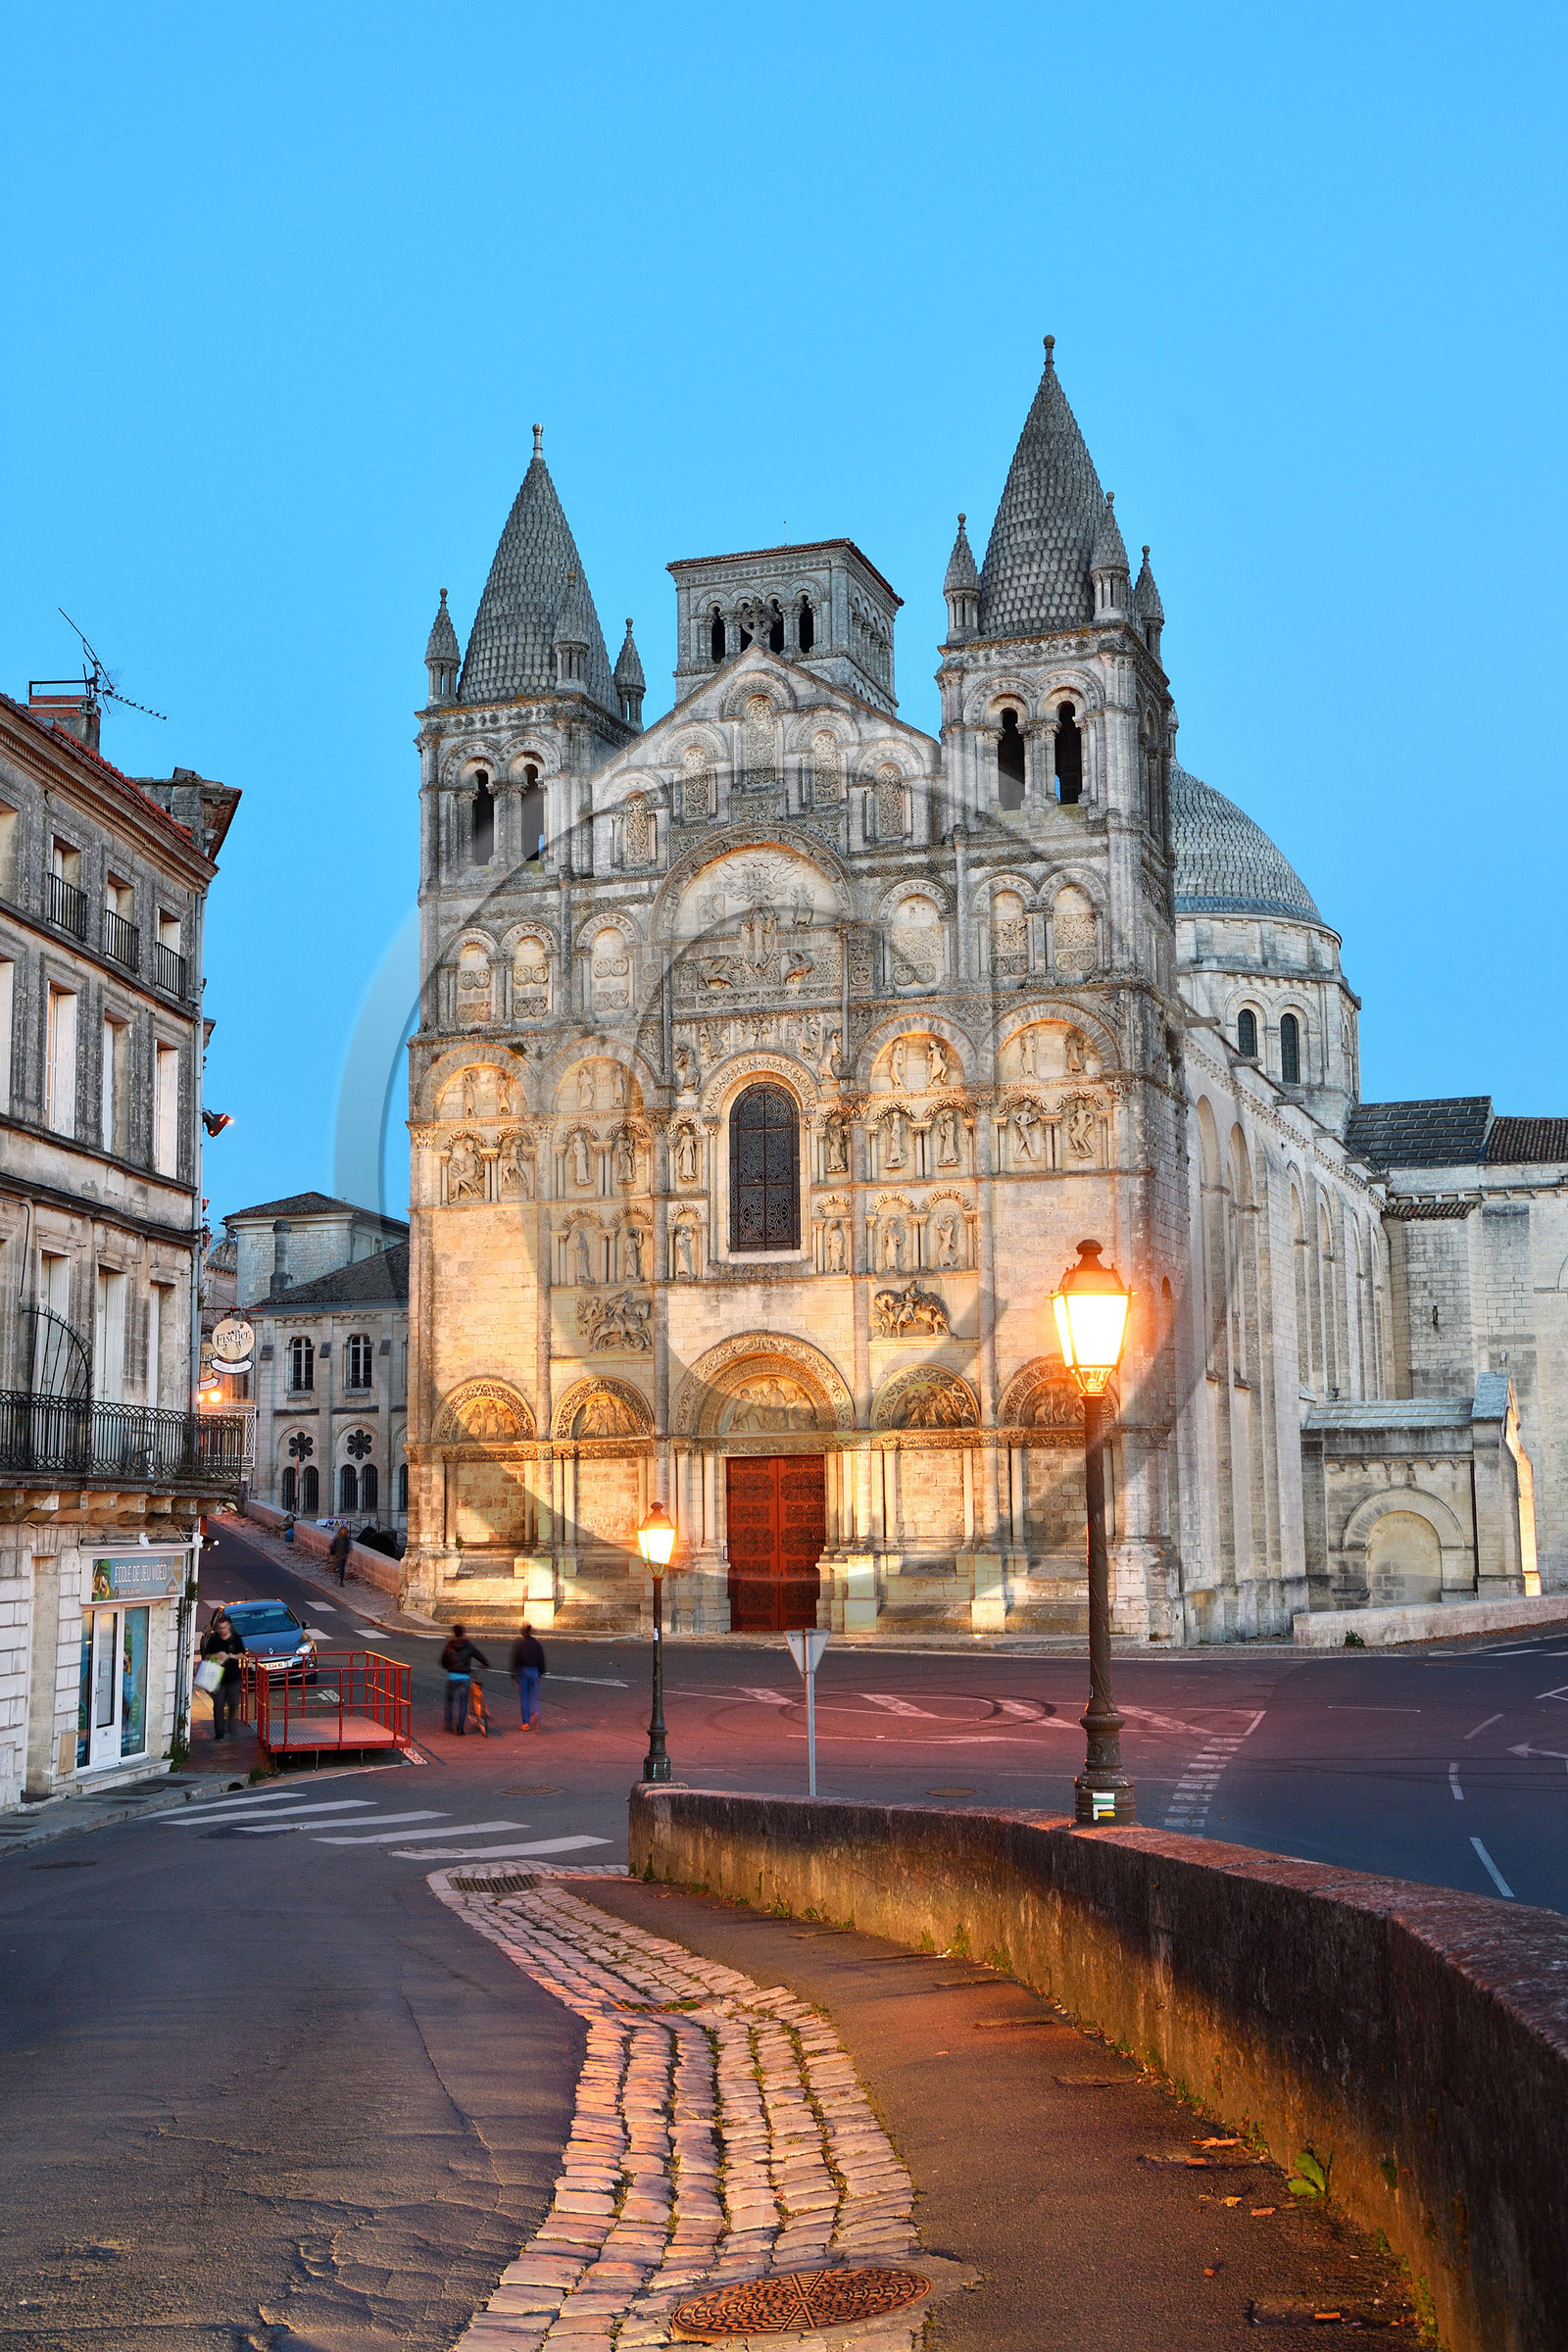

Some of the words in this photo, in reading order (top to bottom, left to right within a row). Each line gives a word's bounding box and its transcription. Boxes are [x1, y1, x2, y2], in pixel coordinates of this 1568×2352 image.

[217, 1330, 250, 1346] Fischer
[115, 1562, 131, 1583] ÉCOLE
[133, 1565, 139, 1582] DE
[141, 1565, 151, 1581] JEU
[152, 1560, 167, 1580] VIDÉO
